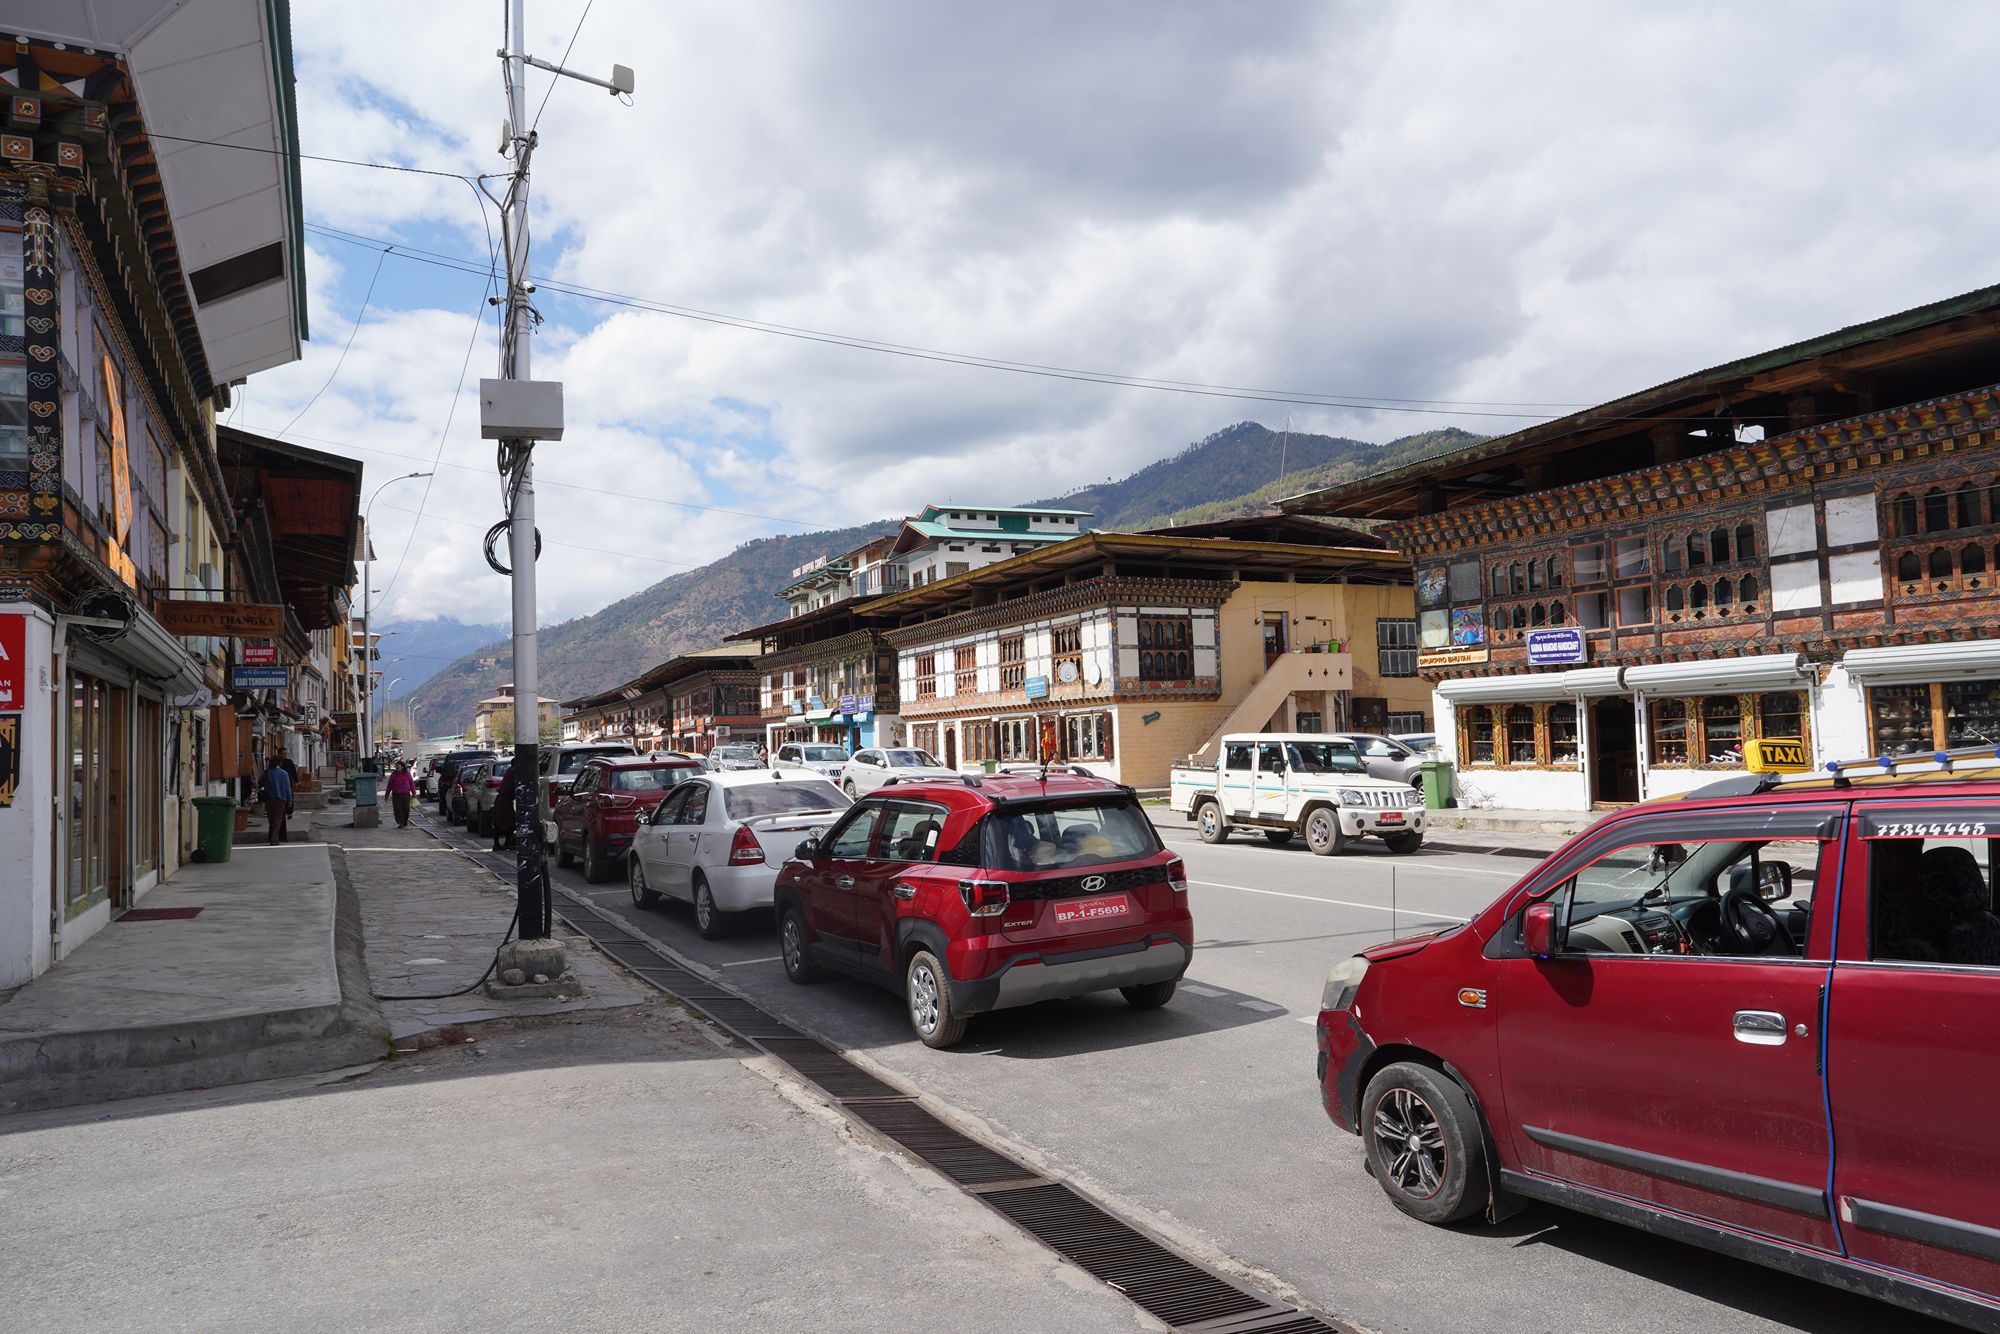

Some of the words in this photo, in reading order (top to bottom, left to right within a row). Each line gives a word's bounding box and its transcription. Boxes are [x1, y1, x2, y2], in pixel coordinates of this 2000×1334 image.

[164, 613, 217, 625] QUALITY
[219, 615, 276, 626] THANGKA
[308, 706, 316, 725] ATM
[1761, 746, 1804, 763] TAXI
[1877, 822, 1986, 837] 77344445
[1057, 904, 1127, 921] BP-1-F5693
[1003, 919, 1033, 928] EXTER
